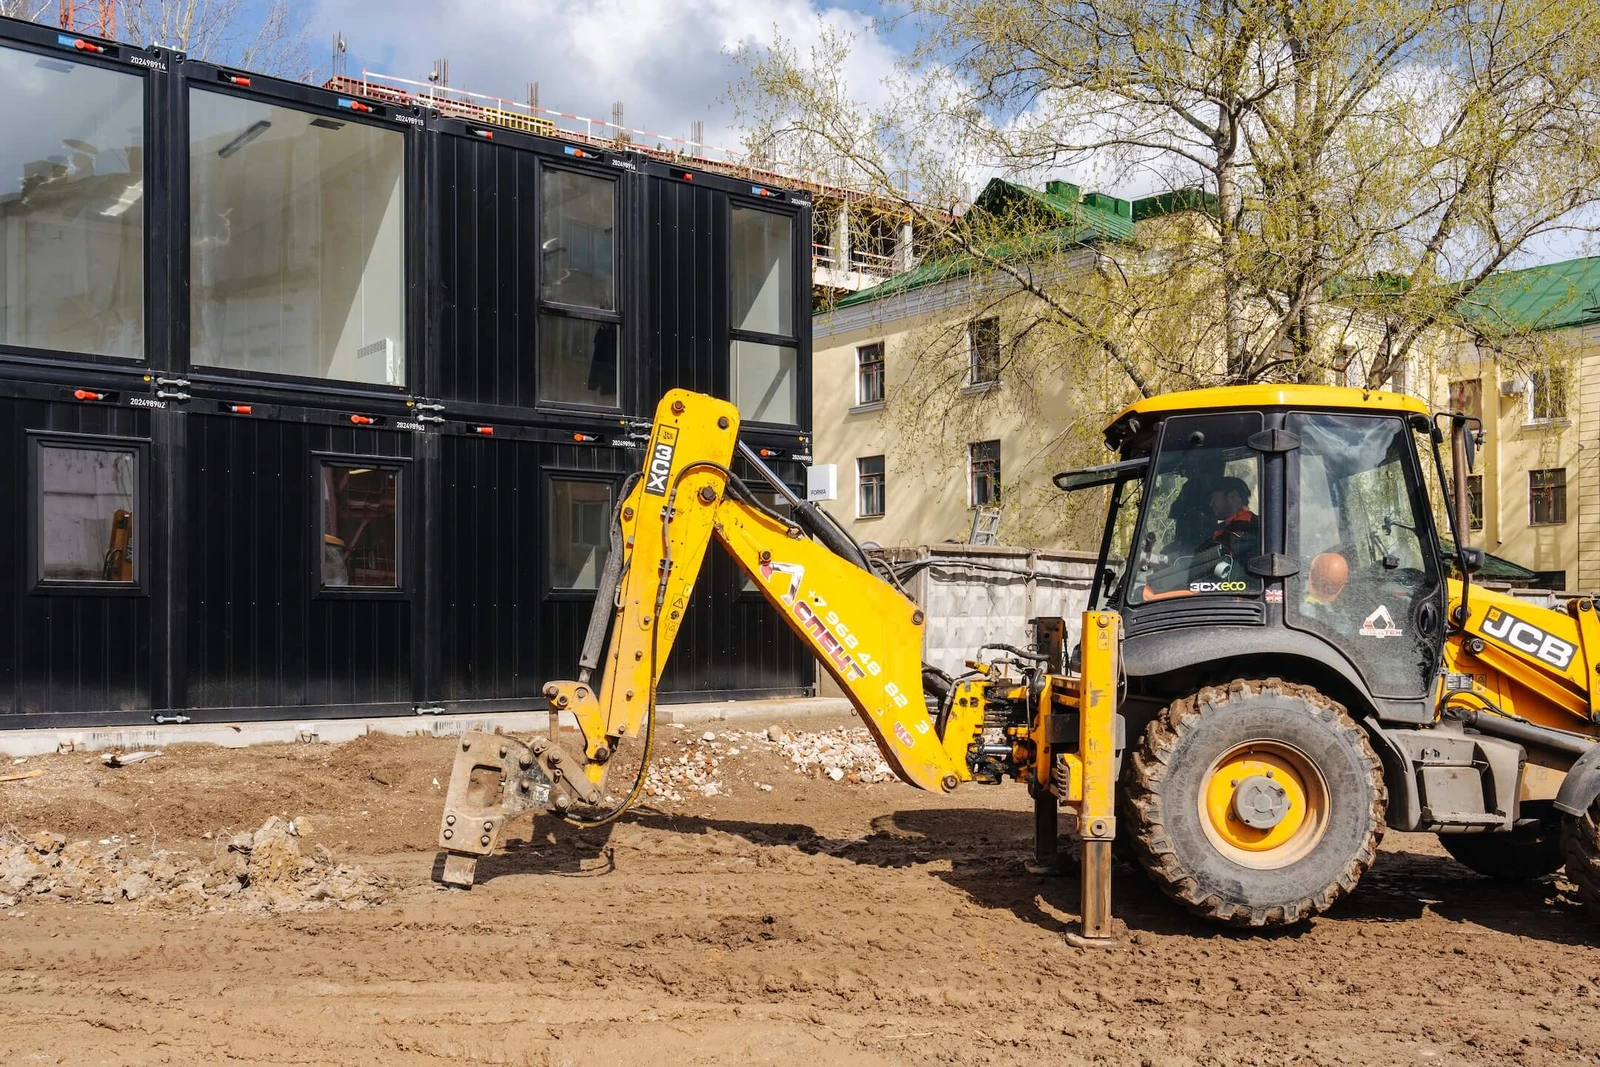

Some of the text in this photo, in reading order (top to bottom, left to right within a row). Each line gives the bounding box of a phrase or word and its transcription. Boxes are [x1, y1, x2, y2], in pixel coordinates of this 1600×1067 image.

[395, 114, 424, 126] 202498915
[130, 397, 165, 408] 202498902
[647, 444, 673, 490] 3CX
[1189, 581, 1246, 592] 3CXeco
[1483, 615, 1573, 668] JCB
[825, 610, 859, 650] 968
[857, 652, 882, 676] 48
[884, 681, 909, 708] 82
[915, 719, 930, 735] 3
